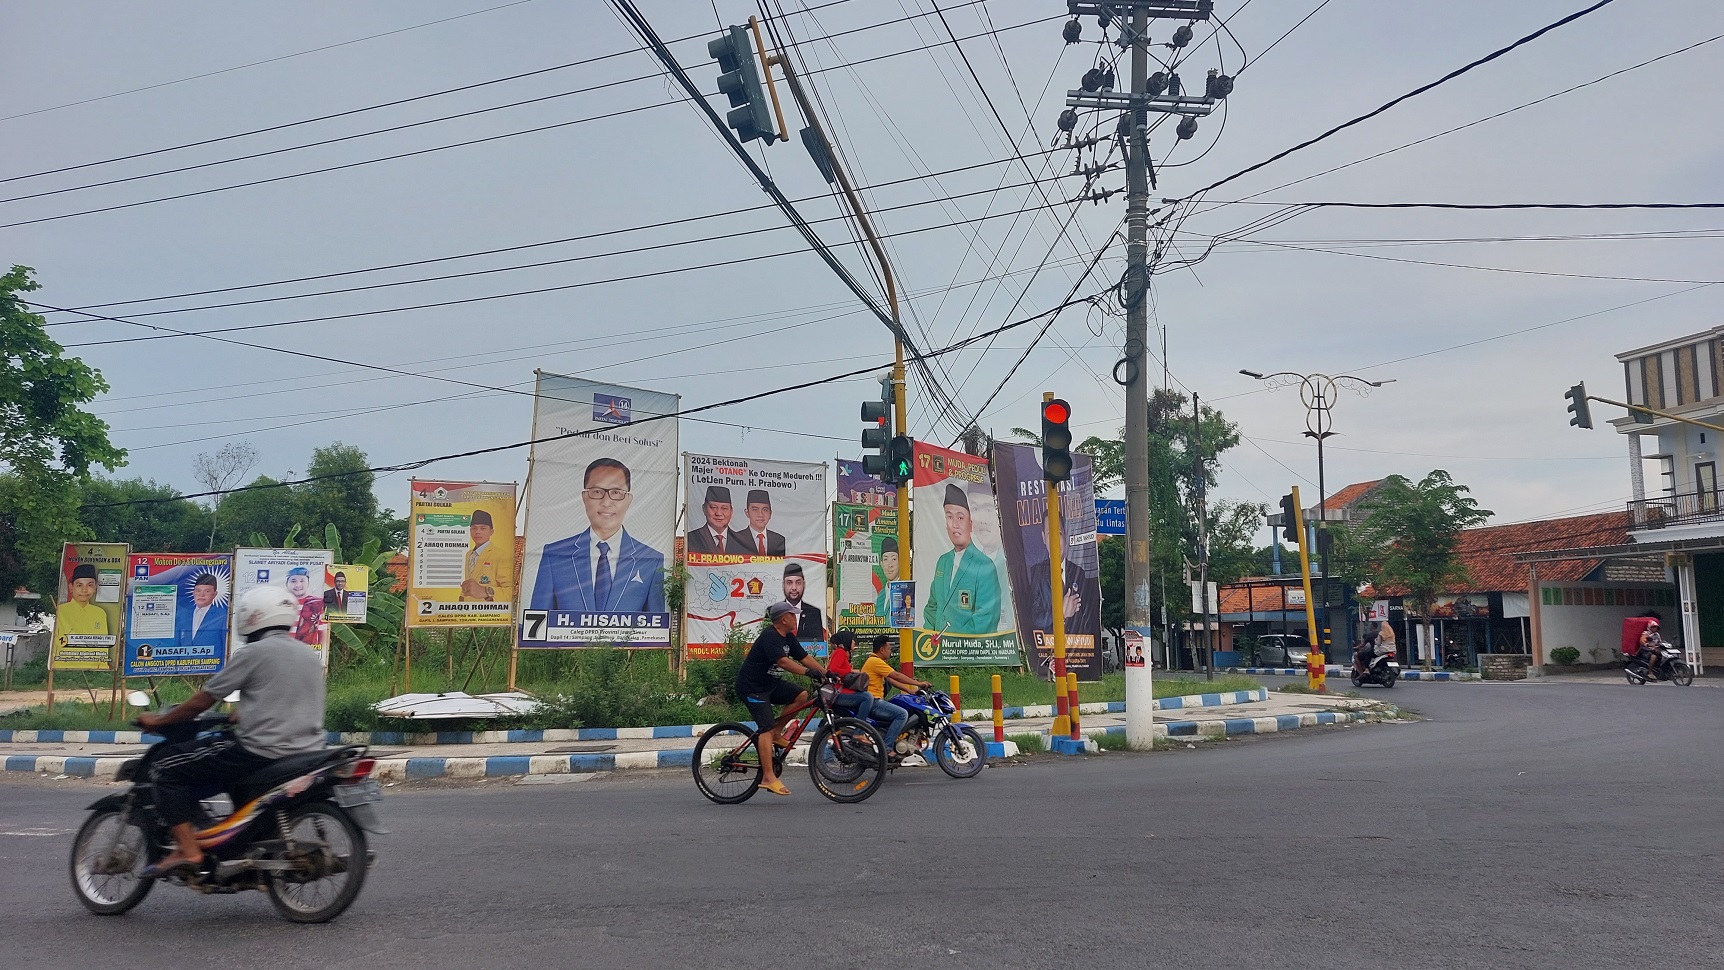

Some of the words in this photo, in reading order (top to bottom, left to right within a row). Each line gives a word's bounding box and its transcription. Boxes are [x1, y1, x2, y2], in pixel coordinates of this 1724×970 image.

[593, 431, 610, 441] dan
[613, 434, 631, 444] Beri
[691, 456, 711, 465] 2024
[712, 458, 748, 468] Bektonah
[919, 453, 931, 469] 17
[691, 465, 714, 475] Majer
[760, 470, 782, 480] Oreng
[725, 477, 747, 486] Purn.
[748, 478, 757, 487] H.
[758, 479, 792, 489] Prabowo
[1020, 476, 1076, 497] RESTASI
[419, 488, 428, 499] 4
[1113, 506, 1126, 515] Tert
[838, 513, 850, 527] 17
[1106, 518, 1125, 528] Lintas
[417, 541, 423, 549] 2
[88, 548, 93, 556] 4
[137, 557, 148, 565] 12
[700, 554, 745, 564] PRABOWO
[749, 555, 784, 564] GIBRAN
[243, 571, 257, 584] 12
[730, 578, 745, 598] 2
[421, 601, 433, 614] 2
[525, 614, 547, 638] 7
[557, 614, 575, 626] H.
[580, 614, 633, 627] HISAN
[637, 615, 662, 627] S.E
[1036, 634, 1043, 645] 5
[141, 646, 148, 657] 1
[155, 648, 190, 656] NASAFI,
[192, 647, 211, 655] S.Ap
[920, 637, 933, 655] 4
[941, 638, 962, 648] Nurul
[963, 639, 984, 649] Huda,
[1003, 639, 1015, 648] MH
